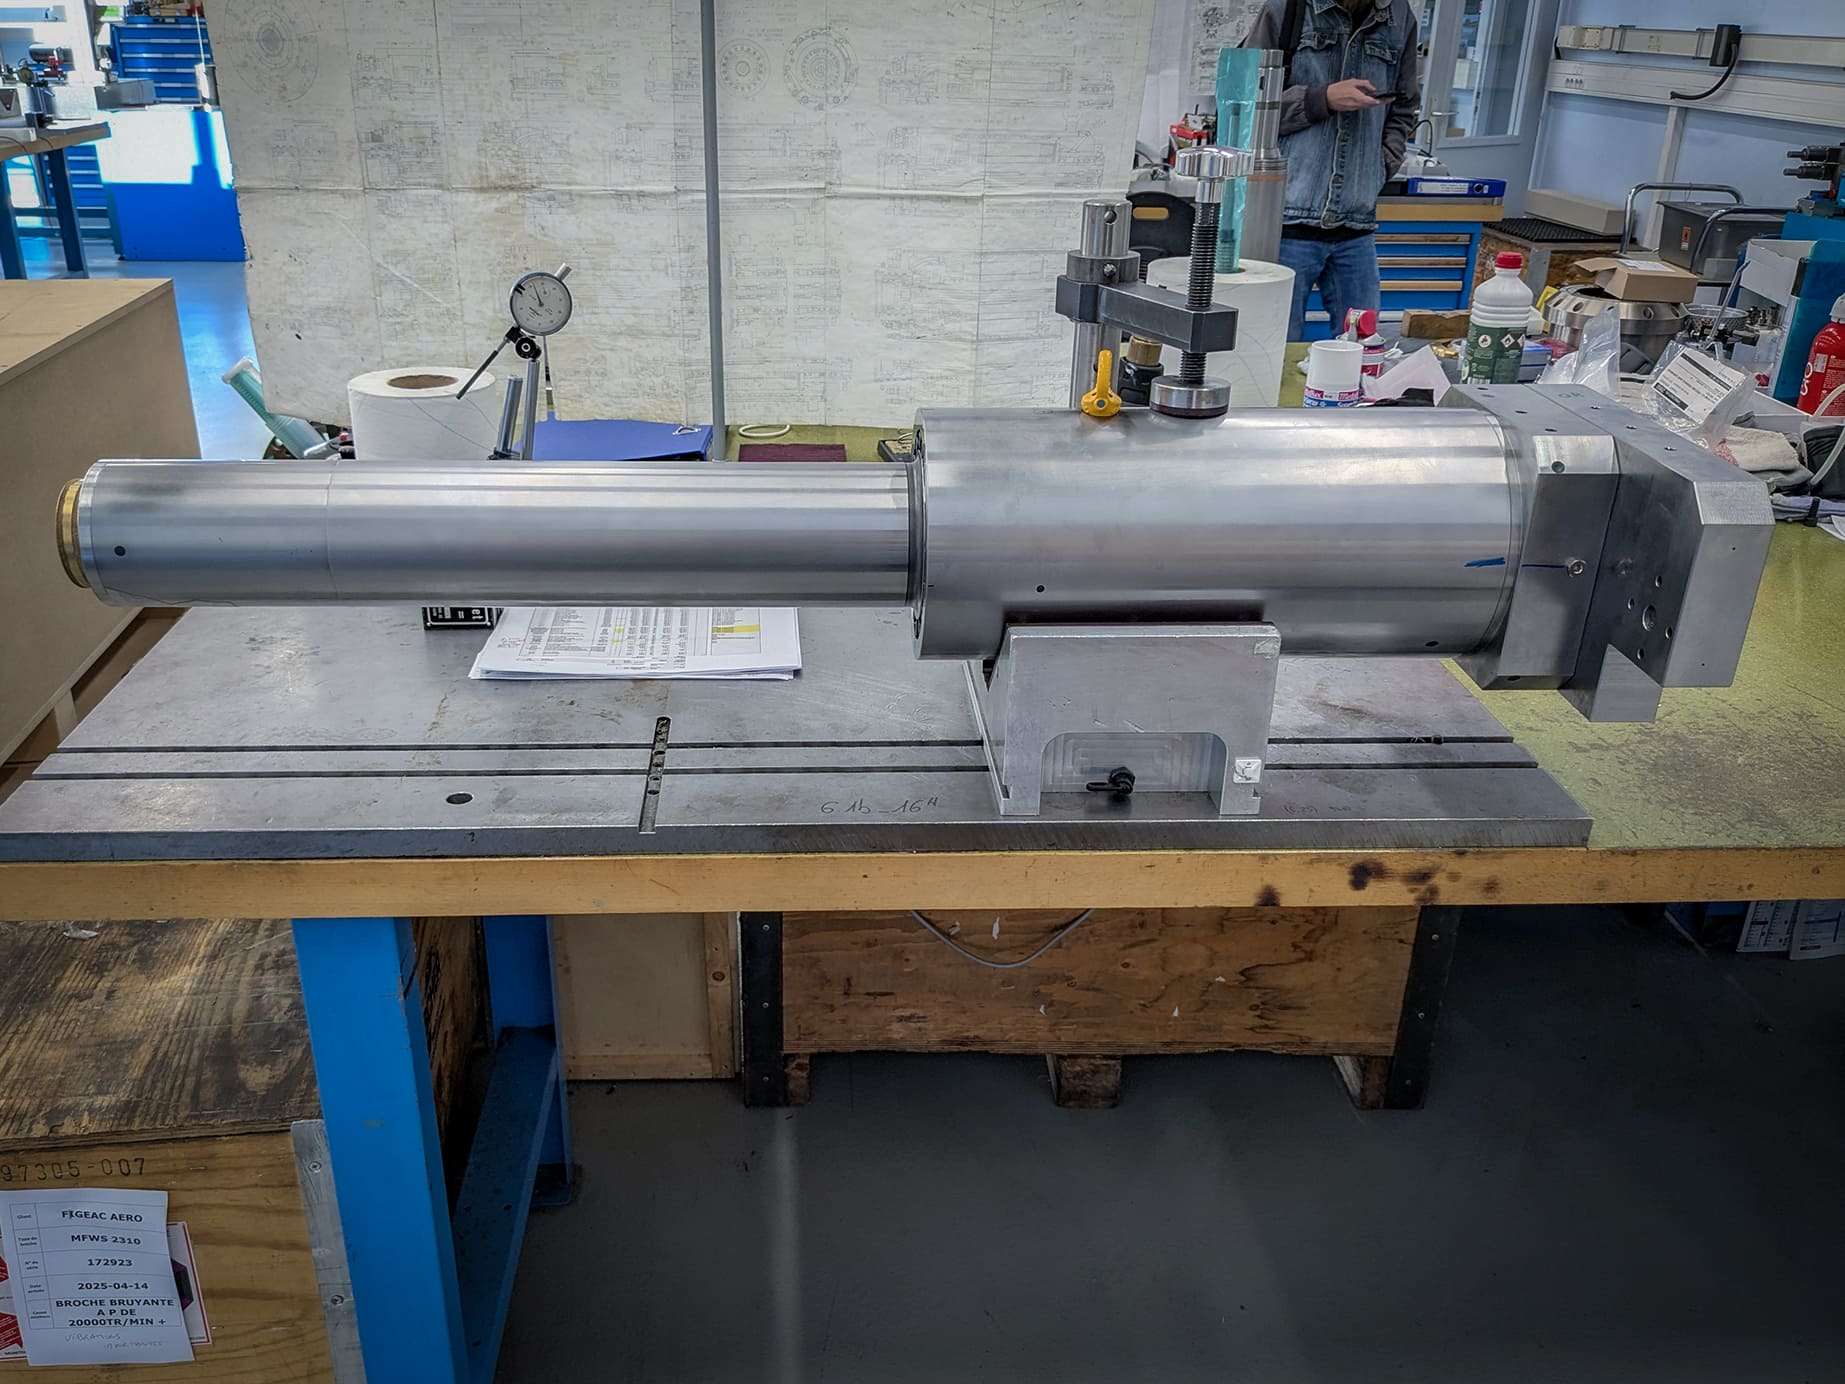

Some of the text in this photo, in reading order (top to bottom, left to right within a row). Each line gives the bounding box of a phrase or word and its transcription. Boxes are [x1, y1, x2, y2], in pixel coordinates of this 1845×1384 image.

[61, 1210, 143, 1222] FIGEAC AERO
[71, 1234, 141, 1245] MFWS 2310
[87, 1258, 133, 1267] 172923
[77, 1282, 149, 1290] 2025-04-14
[55, 1299, 106, 1307] BROCHE
[120, 1308, 137, 1316] DE
